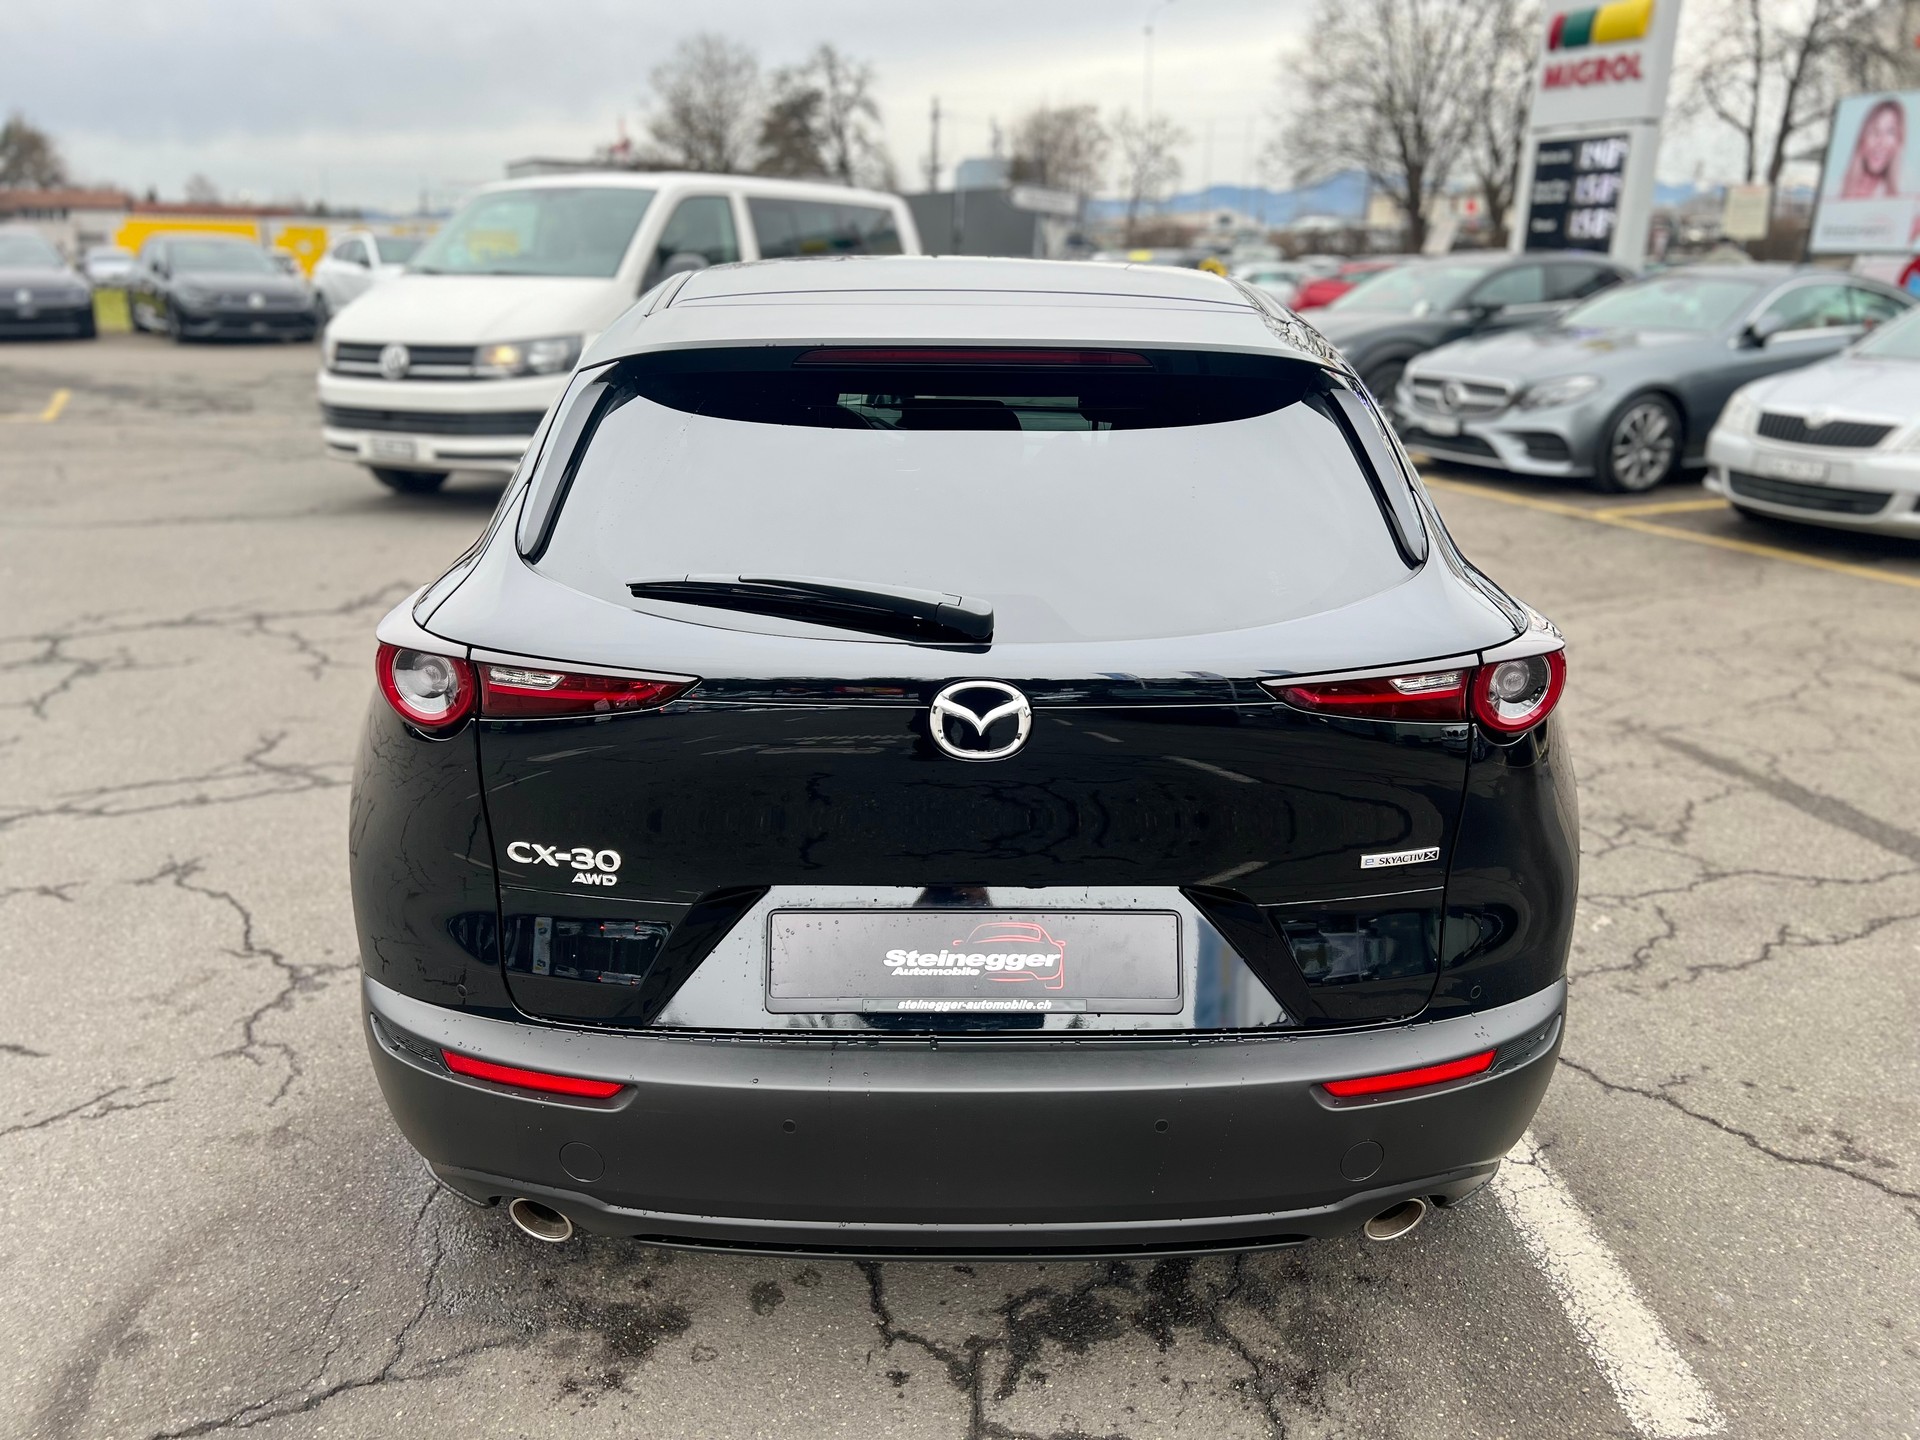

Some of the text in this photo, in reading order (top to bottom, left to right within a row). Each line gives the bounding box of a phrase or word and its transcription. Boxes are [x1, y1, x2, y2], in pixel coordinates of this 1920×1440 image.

[1542, 52, 1643, 91] MIGROL
[506, 841, 622, 872] CX-30
[571, 872, 618, 887] AWD
[883, 949, 1062, 972] Steinegger
[891, 967, 981, 977] Automobile
[897, 999, 1052, 1012] steinegger-automobile.ch
